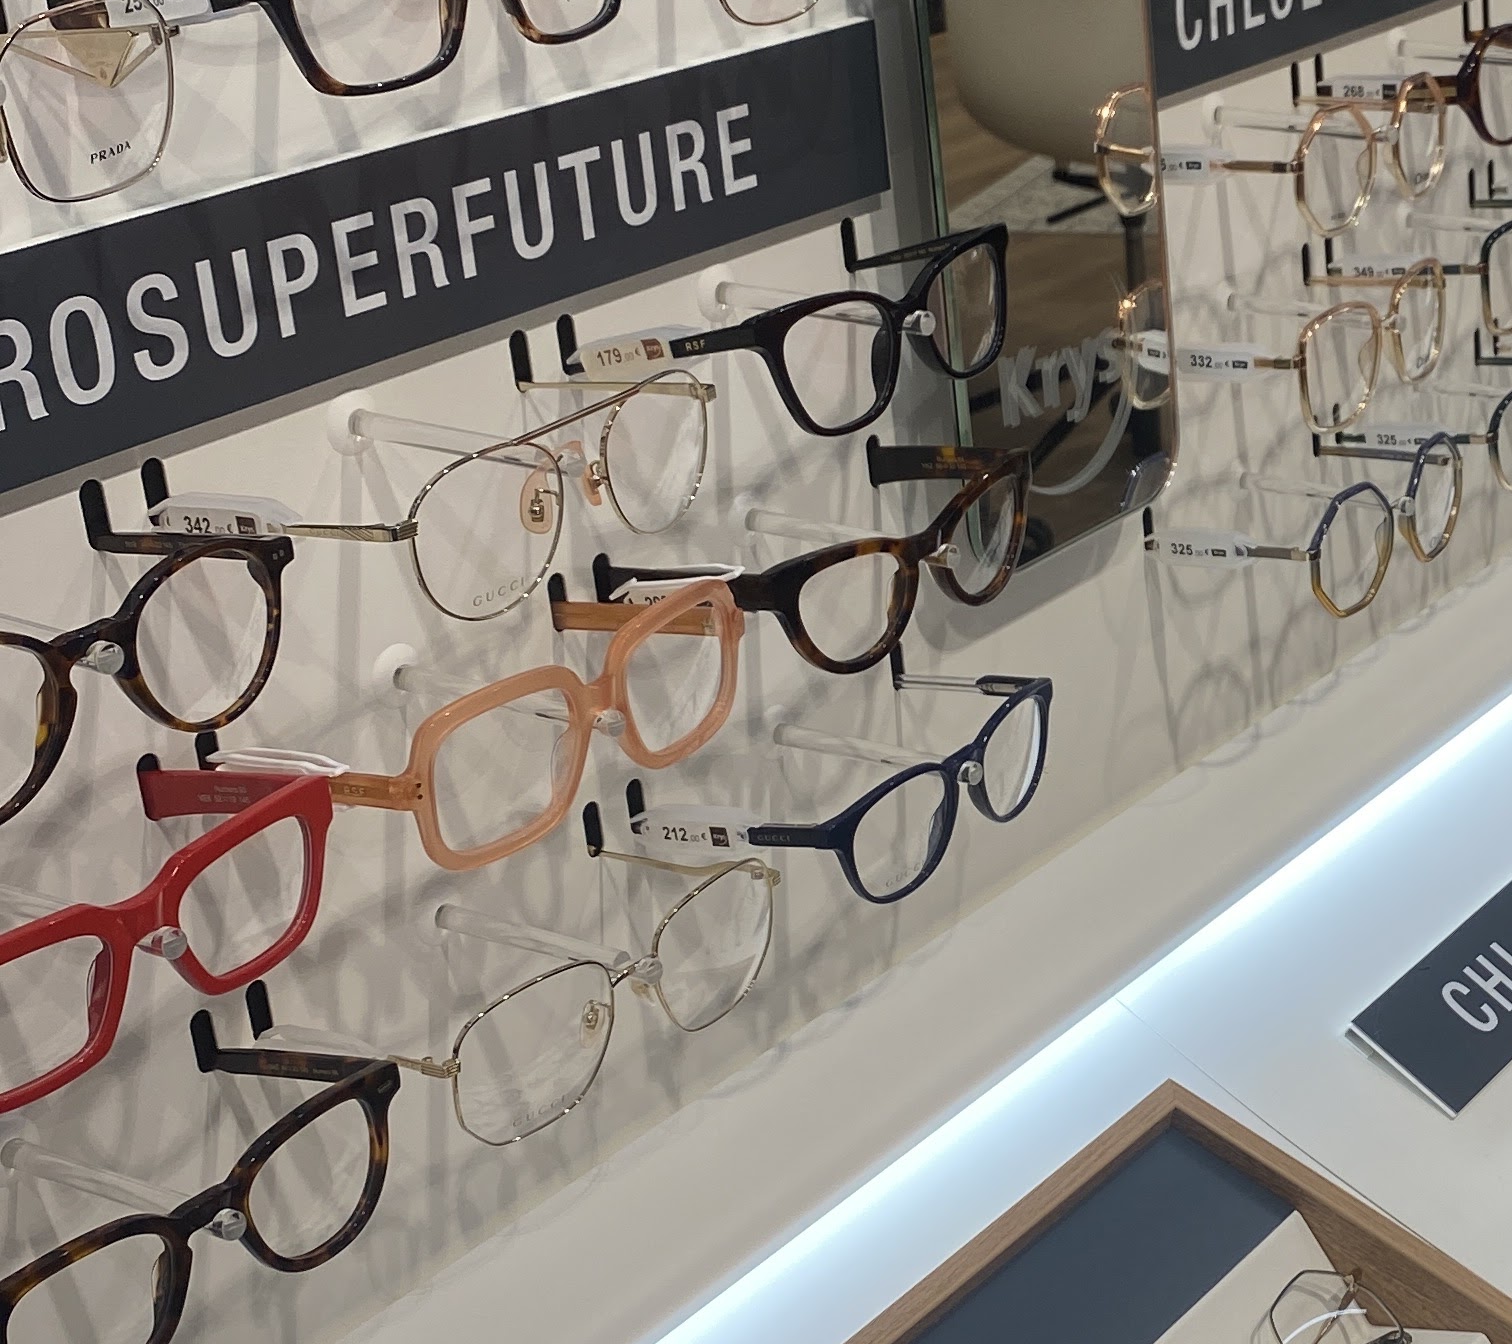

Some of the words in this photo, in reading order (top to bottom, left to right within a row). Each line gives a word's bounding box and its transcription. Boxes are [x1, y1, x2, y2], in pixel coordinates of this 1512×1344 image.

[90, 141, 131, 164] PRADA
[685, 340, 707, 353] RSF
[1000, 329, 1123, 428] Krys
[473, 577, 526, 607] GUCCI
